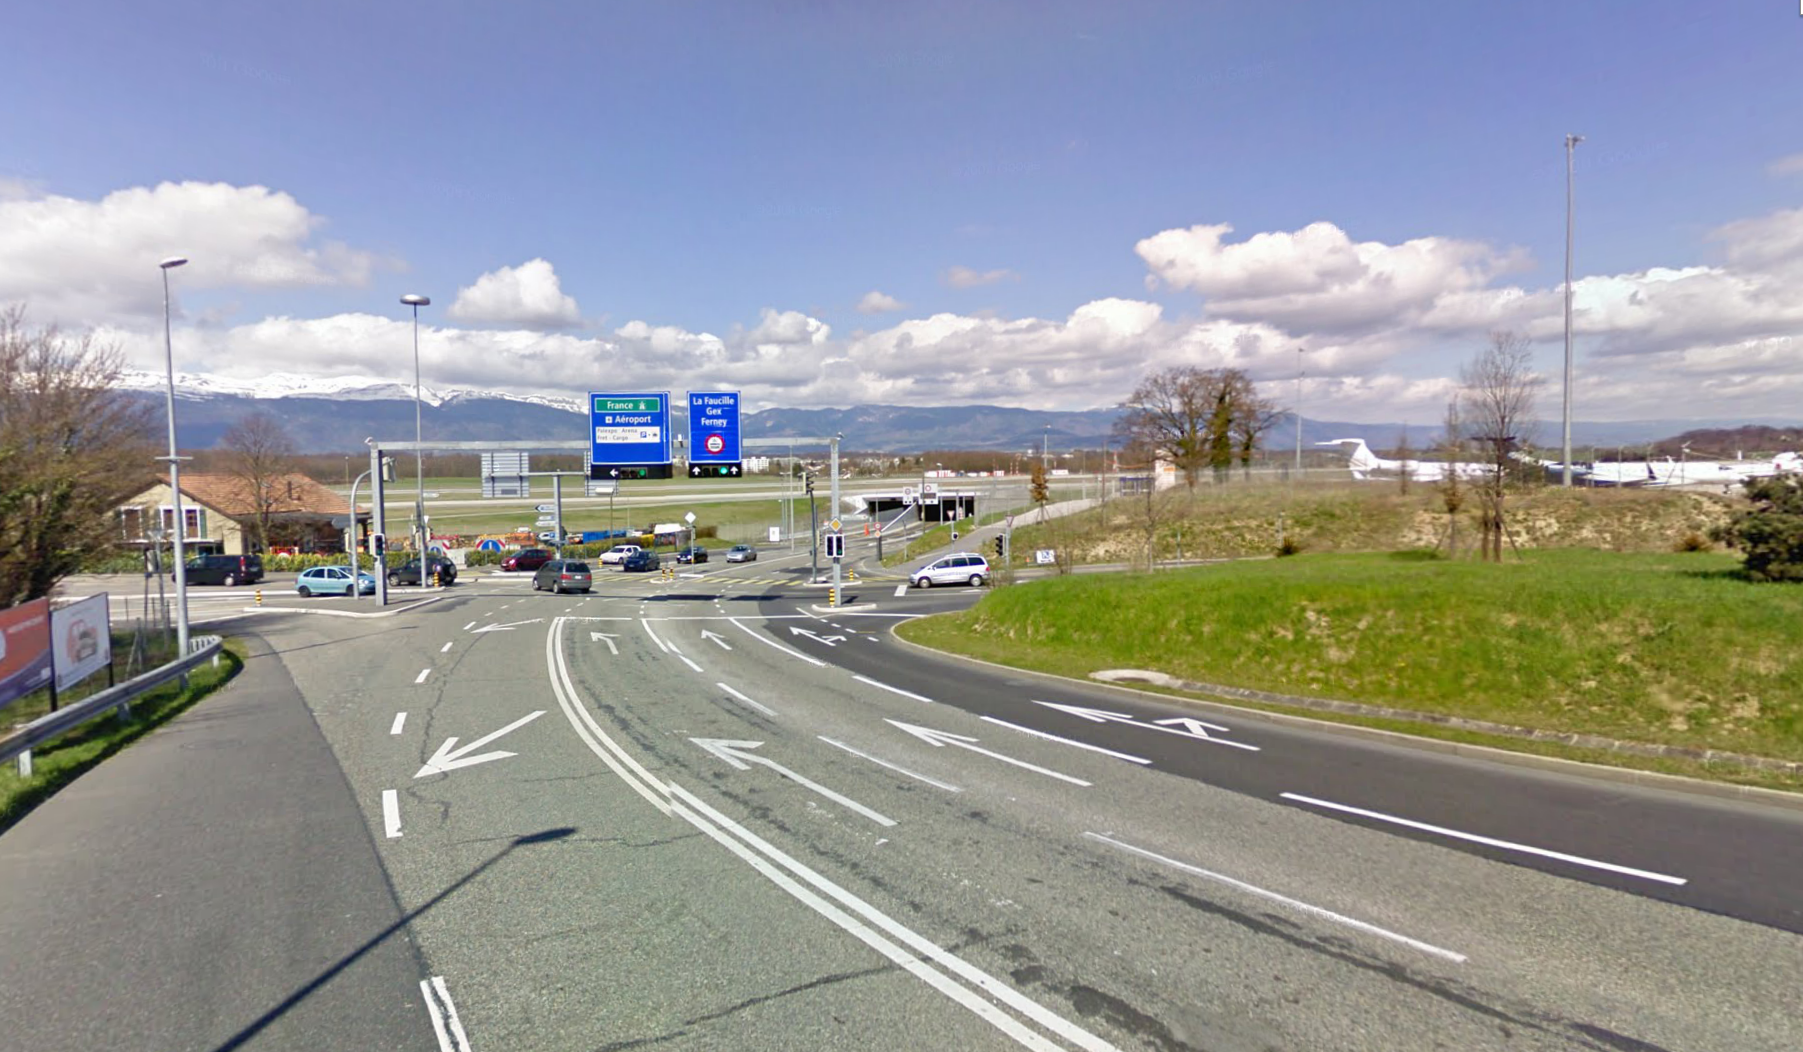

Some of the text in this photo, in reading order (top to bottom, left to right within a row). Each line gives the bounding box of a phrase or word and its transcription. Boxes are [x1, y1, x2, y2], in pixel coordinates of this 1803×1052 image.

[607, 401, 633, 409] France
[693, 396, 735, 405] La Faucille
[706, 407, 722, 415] Gex
[615, 415, 652, 425] Aéroport
[701, 417, 728, 427] Ferney
